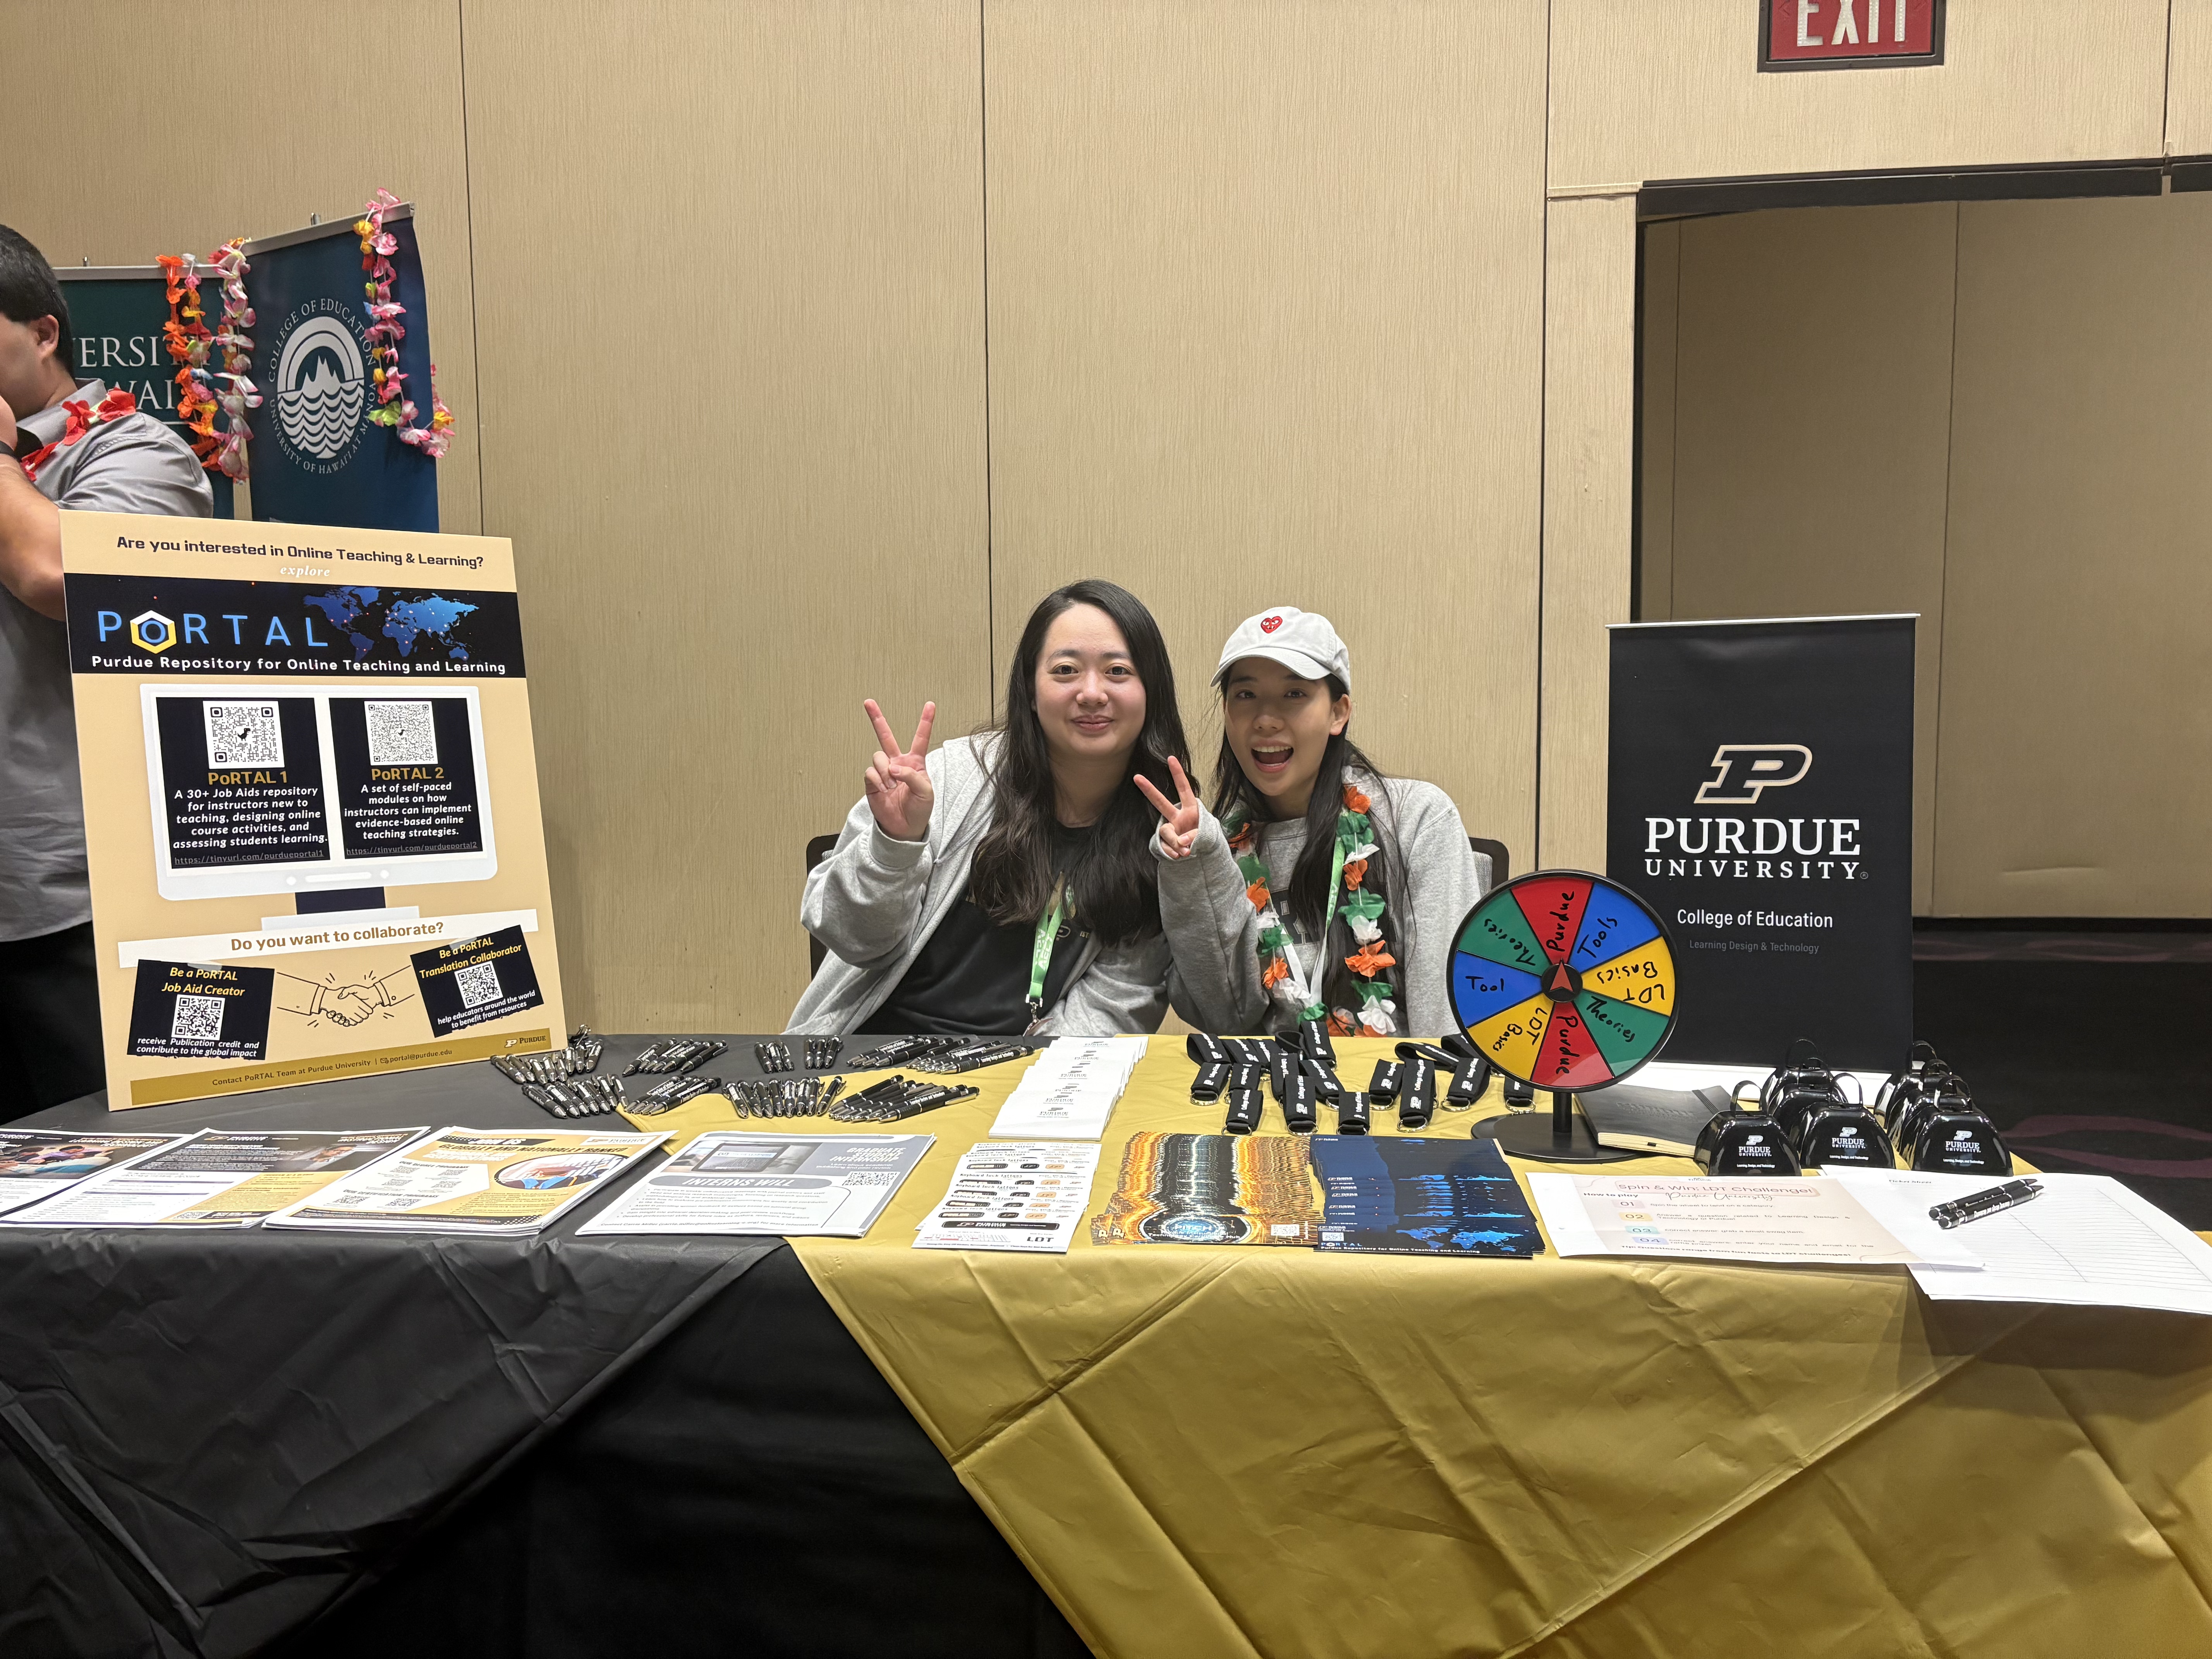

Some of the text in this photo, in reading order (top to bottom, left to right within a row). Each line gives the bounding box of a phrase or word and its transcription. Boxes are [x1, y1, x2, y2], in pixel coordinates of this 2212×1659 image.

[269, 298, 376, 382] COLLEGE OF EDUCATION
[270, 398, 301, 465] UNIVERSITY
[303, 461, 315, 472] OF
[352, 435, 361, 453] AT
[117, 536, 483, 569] Are you interested in Online Teaching & Learning?
[280, 566, 330, 577] explore
[92, 656, 505, 674] Purdue Repository for Online Teaching and Learning
[280, 771, 287, 783] 1
[435, 767, 444, 779] 2
[174, 787, 318, 799] A 30+ Job Aids repository
[361, 782, 452, 793] A set of self-paced
[188, 802, 204, 812] for
[208, 800, 268, 810] instructors
[369, 795, 409, 804] modules
[177, 810, 321, 824] teaching, designing online
[345, 807, 398, 817] instructors
[422, 804, 471, 814] implement
[191, 822, 309, 835] course activities, and
[356, 816, 464, 828] evidence-based online
[173, 833, 328, 849] assessing students learning.
[363, 827, 459, 840] teaching strategies.
[1645, 818, 1860, 855] PURDUE
[1546, 891, 1575, 952] Purdue
[1678, 909, 1833, 928] College of Education
[231, 922, 443, 950] Do you want to collaborate?
[1484, 919, 1536, 966] Theories
[1577, 917, 1618, 958] Tools
[439, 950, 451, 959] Be
[1690, 939, 1819, 955] Learning Design & Technology
[419, 944, 522, 979] Translation Collaborator
[170, 967, 184, 977] Be
[1597, 962, 1657, 984] Basics
[161, 983, 245, 996] Job Aid Creator
[1465, 976, 1504, 991] Tool
[1623, 984, 1664, 1003] LDT
[438, 990, 535, 1025] help educators around the world
[459, 1015, 481, 1027] benefit
[482, 1010, 497, 1020] from
[498, 1001, 527, 1014] resources
[1527, 1008, 1547, 1045] LDT
[1586, 996, 1635, 1042] Theories
[170, 1038, 214, 1046] Publication
[218, 1040, 240, 1048] credit
[1493, 1024, 1523, 1052] Basics
[1556, 1015, 1579, 1074] Purdue
[212, 1077, 242, 1085] Contact
[276, 1069, 296, 1077] Team
[308, 1064, 333, 1074] Purdue
[335, 1060, 371, 1072] University
[438, 1143, 493, 1152] GLOBALLY
[682, 1178, 755, 1187] INTERNS
[1619, 1184, 1650, 1192] Spin
[1666, 1192, 1774, 1201] Purdue University
